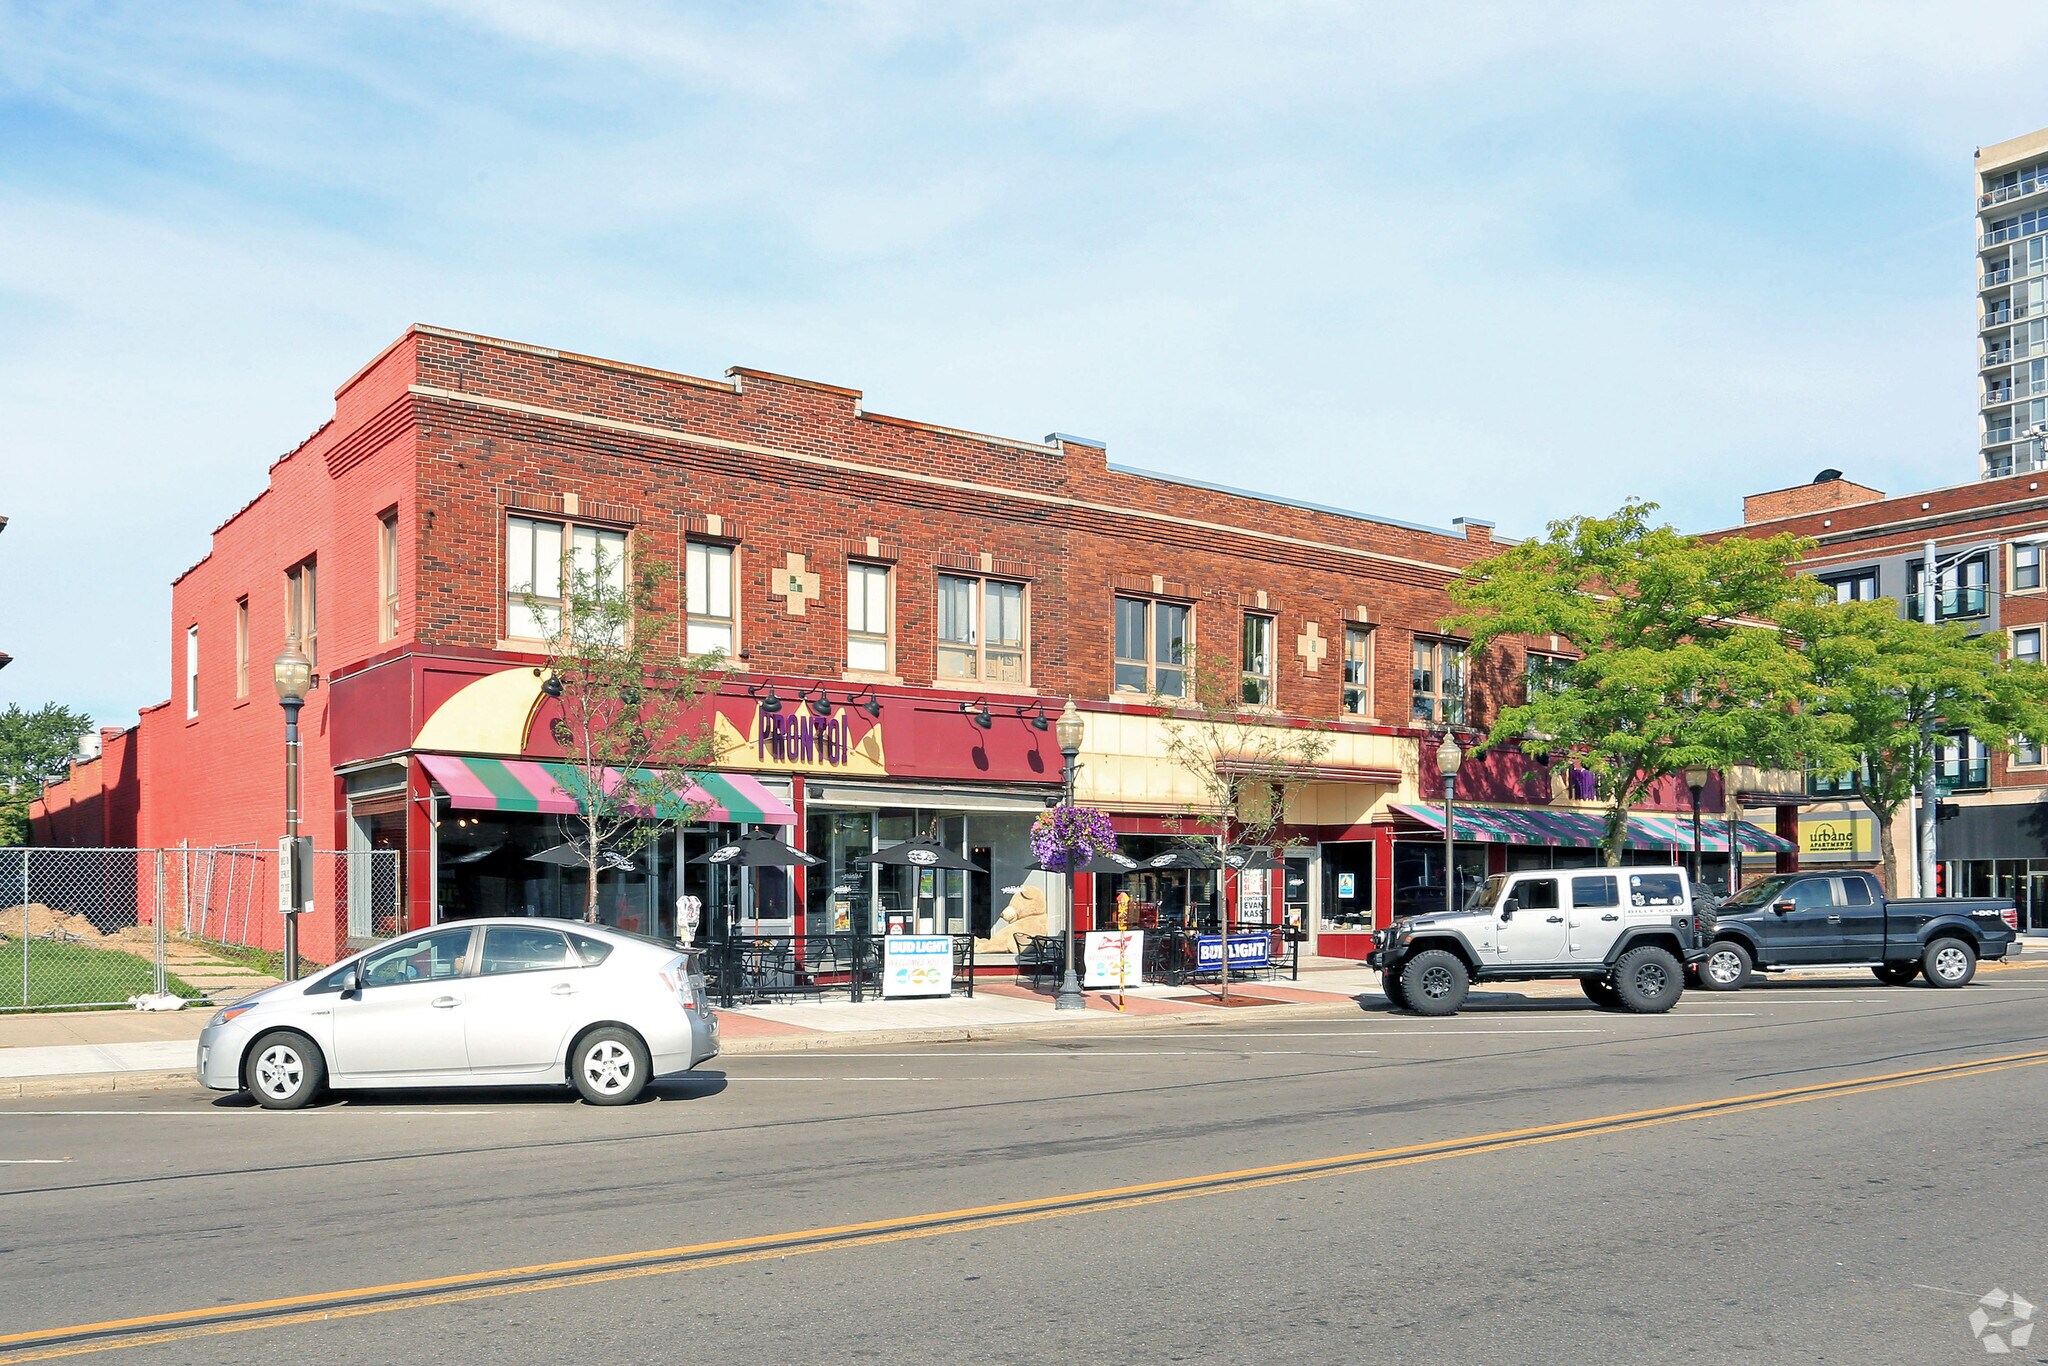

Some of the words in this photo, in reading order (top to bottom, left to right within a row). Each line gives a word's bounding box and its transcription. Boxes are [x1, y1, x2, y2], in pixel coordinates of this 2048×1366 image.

[758, 703, 848, 763] PRONTO!
[1810, 828, 1853, 841] urbane
[890, 941, 915, 952] BUD
[916, 941, 948, 952] LIGHT
[1228, 943, 1265, 958] LIGHT
